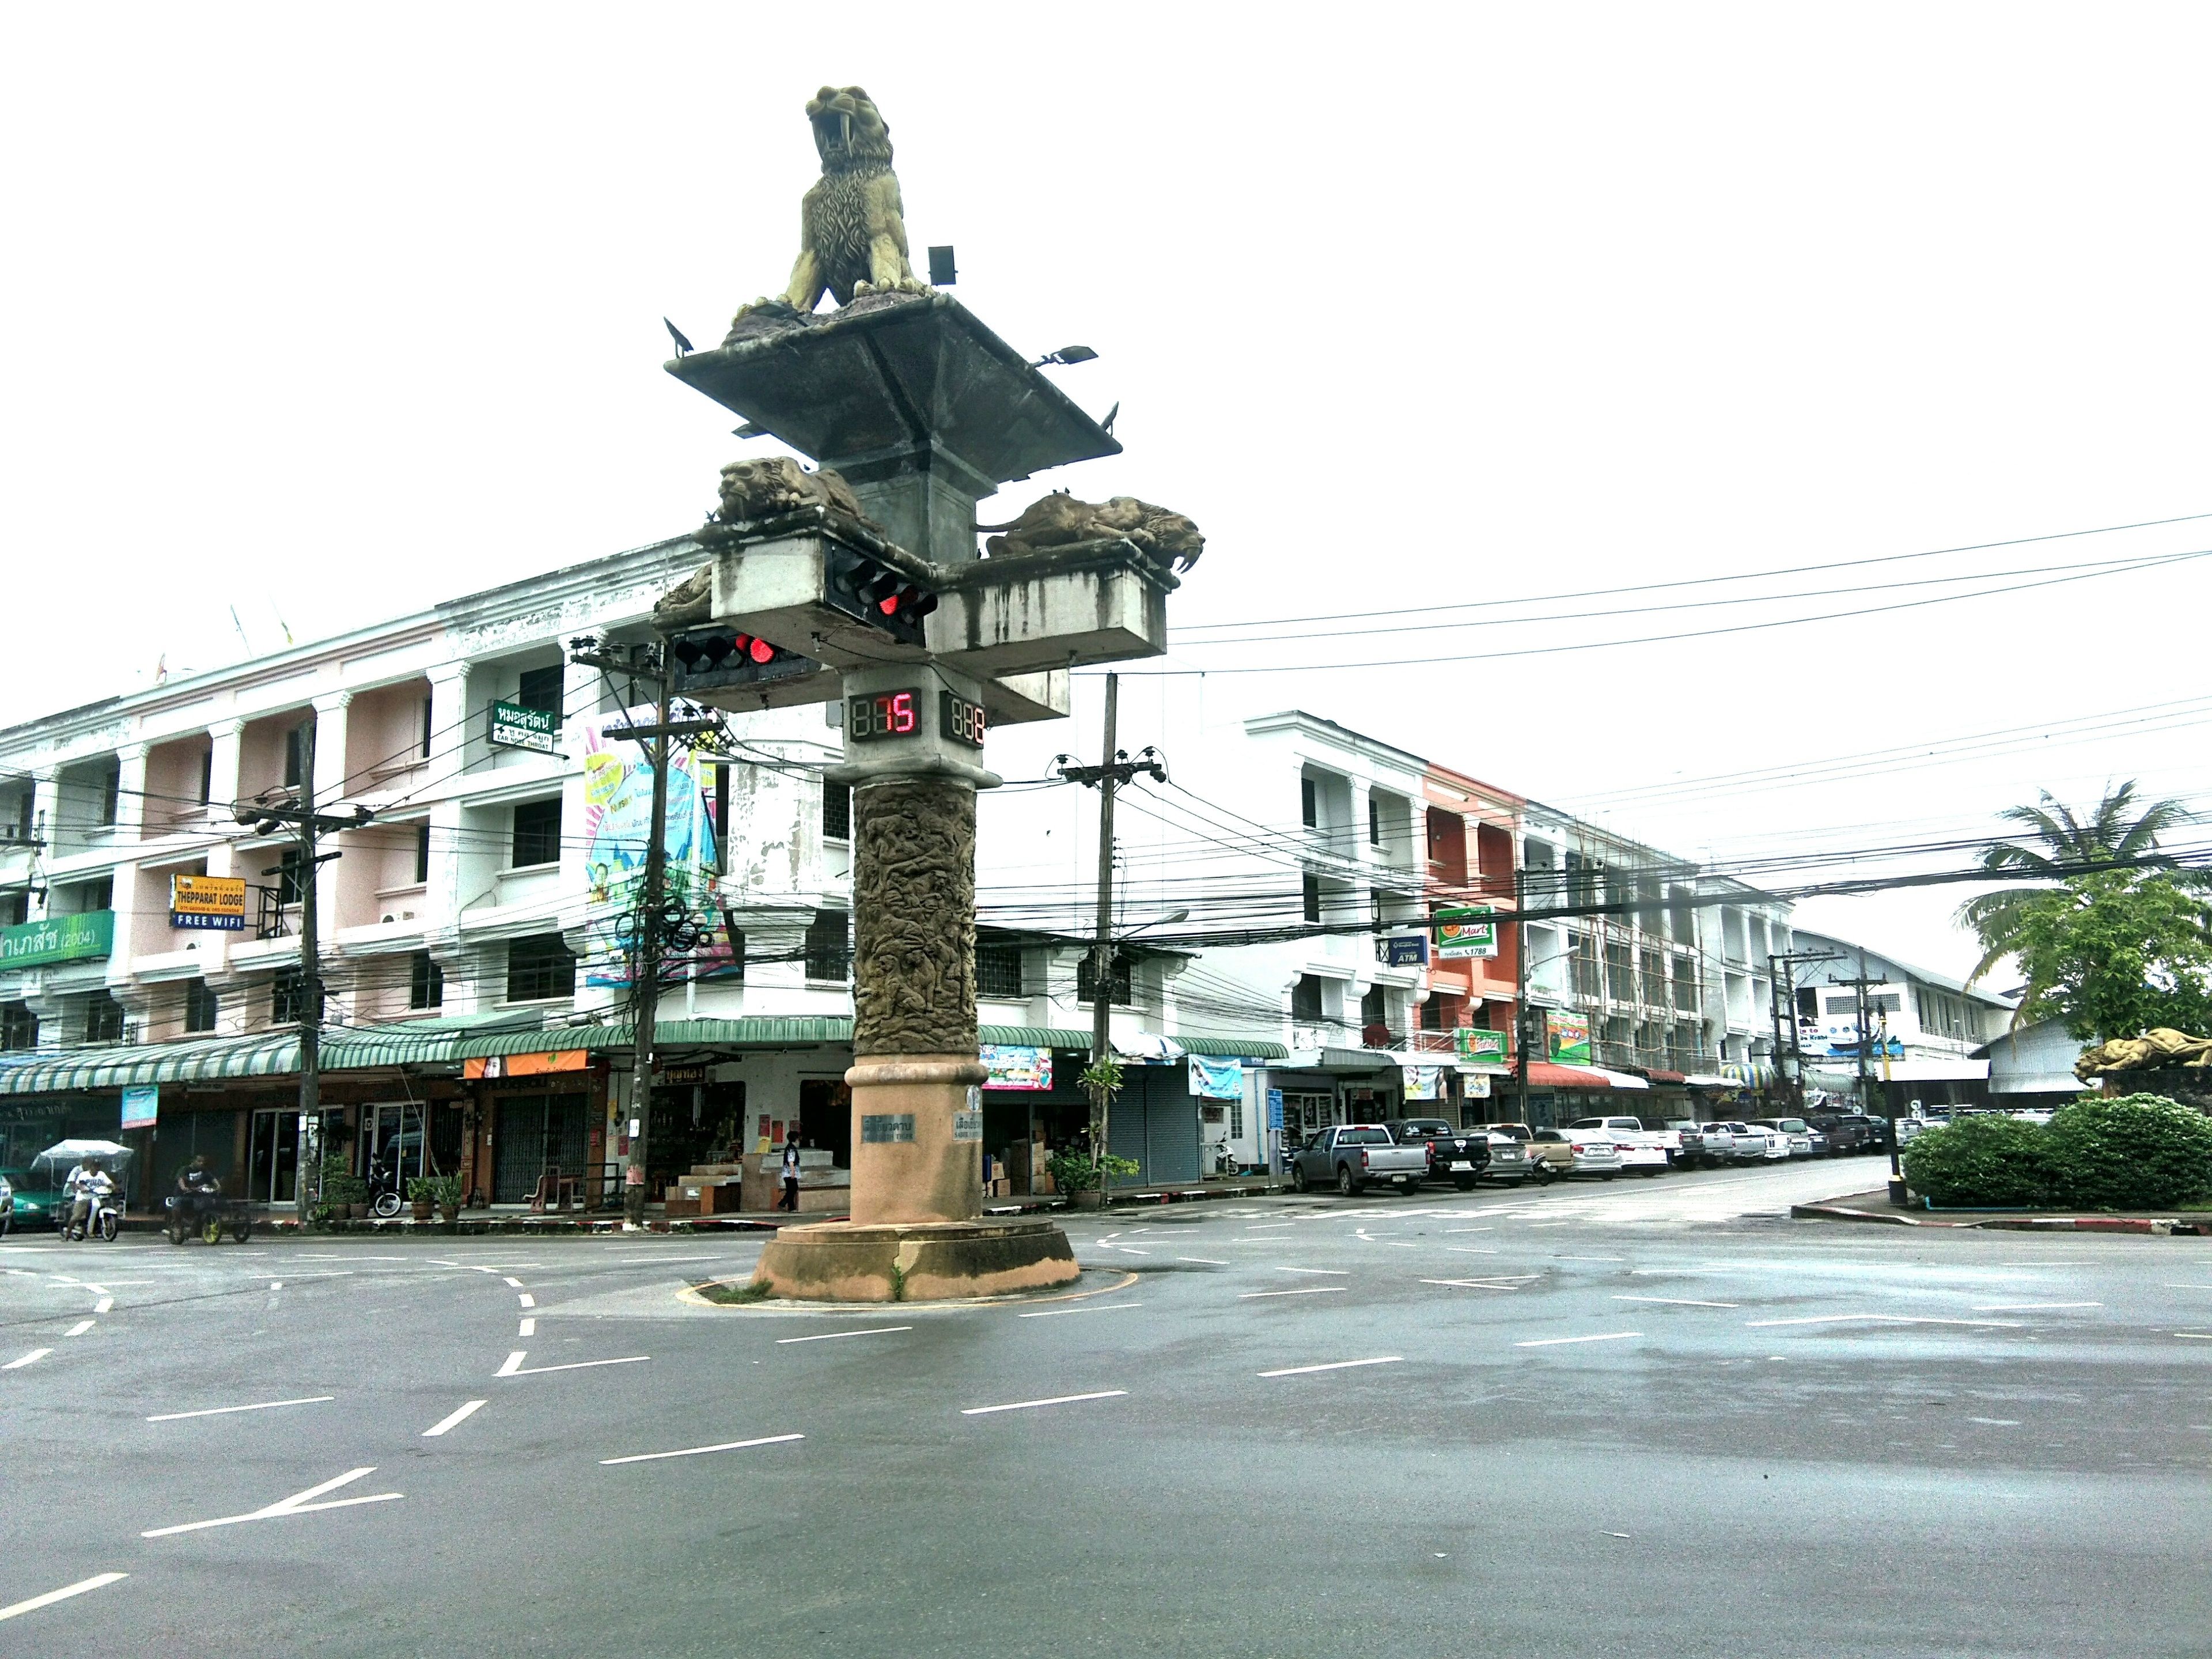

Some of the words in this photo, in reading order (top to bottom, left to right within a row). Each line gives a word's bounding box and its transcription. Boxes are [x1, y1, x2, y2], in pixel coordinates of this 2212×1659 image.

[498, 707, 551, 730] หมอสุรัตน์
[527, 740, 548, 749] THROAT
[177, 891, 217, 905] THEPPARAT
[219, 893, 243, 906] LODGE
[178, 915, 207, 926] FREE
[213, 916, 240, 927] WIFI
[1462, 925, 1486, 937] Mart
[1397, 954, 1418, 963] ATM
